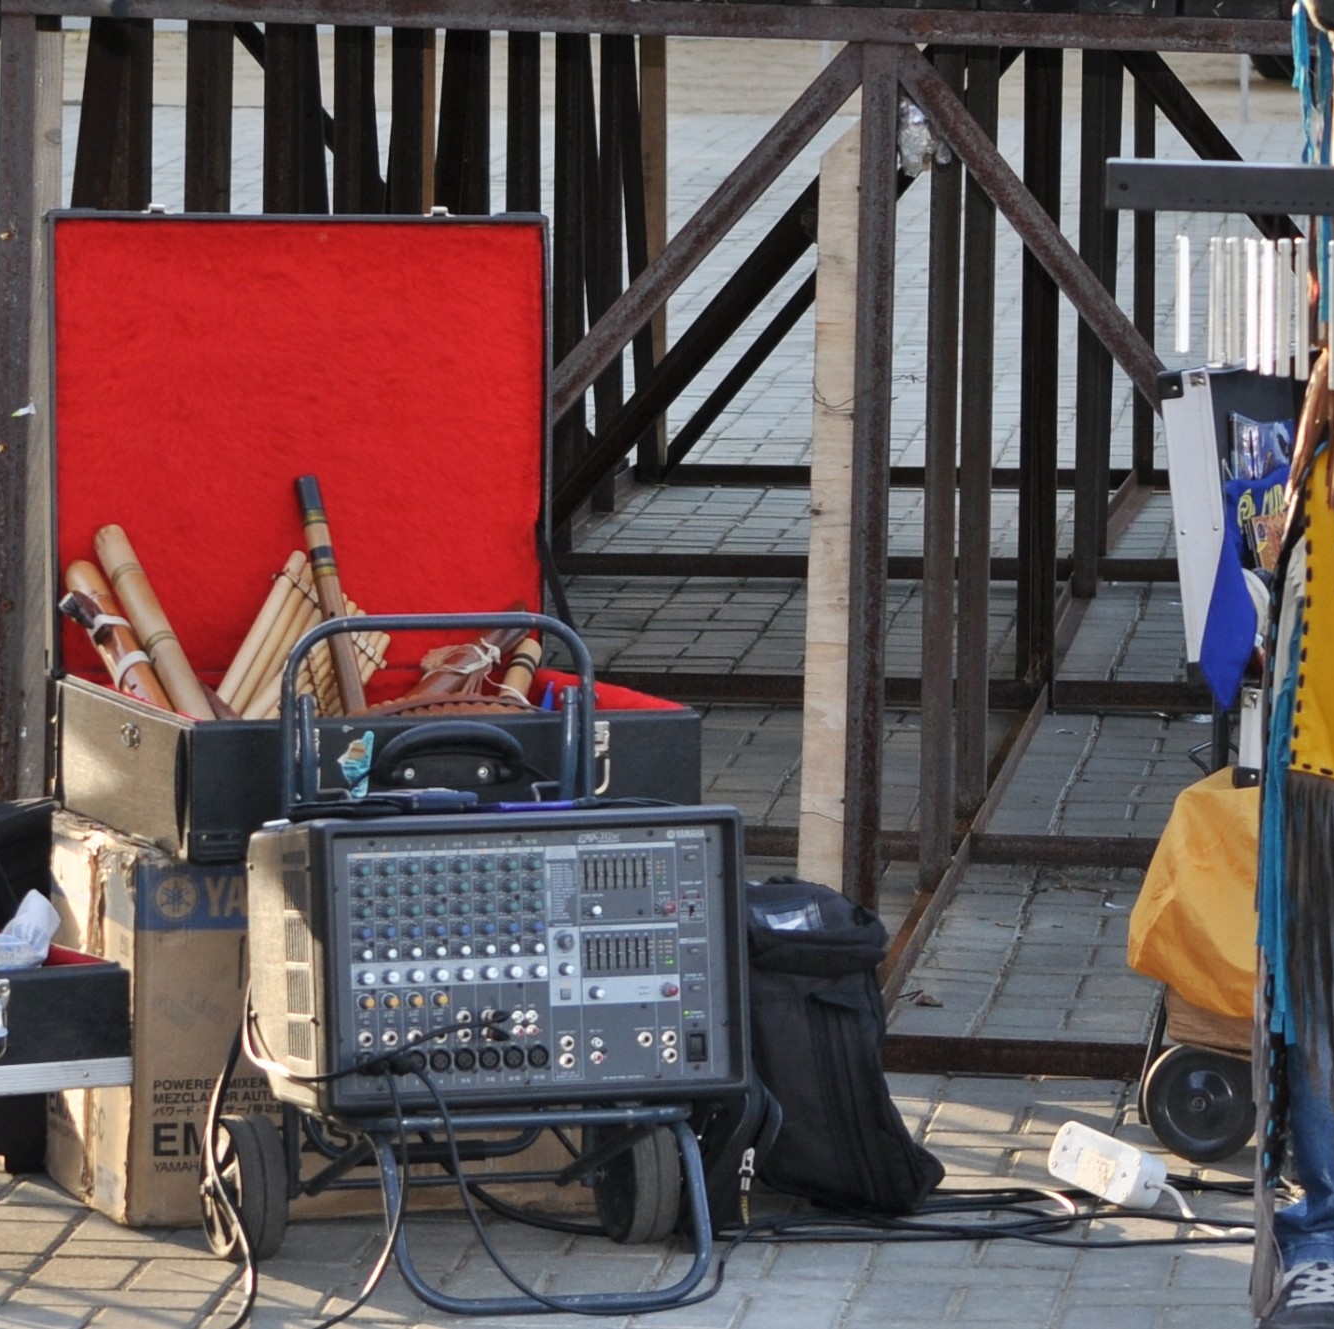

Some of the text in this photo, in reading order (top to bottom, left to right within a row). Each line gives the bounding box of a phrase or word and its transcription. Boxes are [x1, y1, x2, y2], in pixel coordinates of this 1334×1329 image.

[204, 876, 248, 918] YA
[153, 1078, 216, 1091] POWERE
[153, 1090, 239, 1104] MEZCLAOR
[154, 1161, 200, 1173] YAMAH
